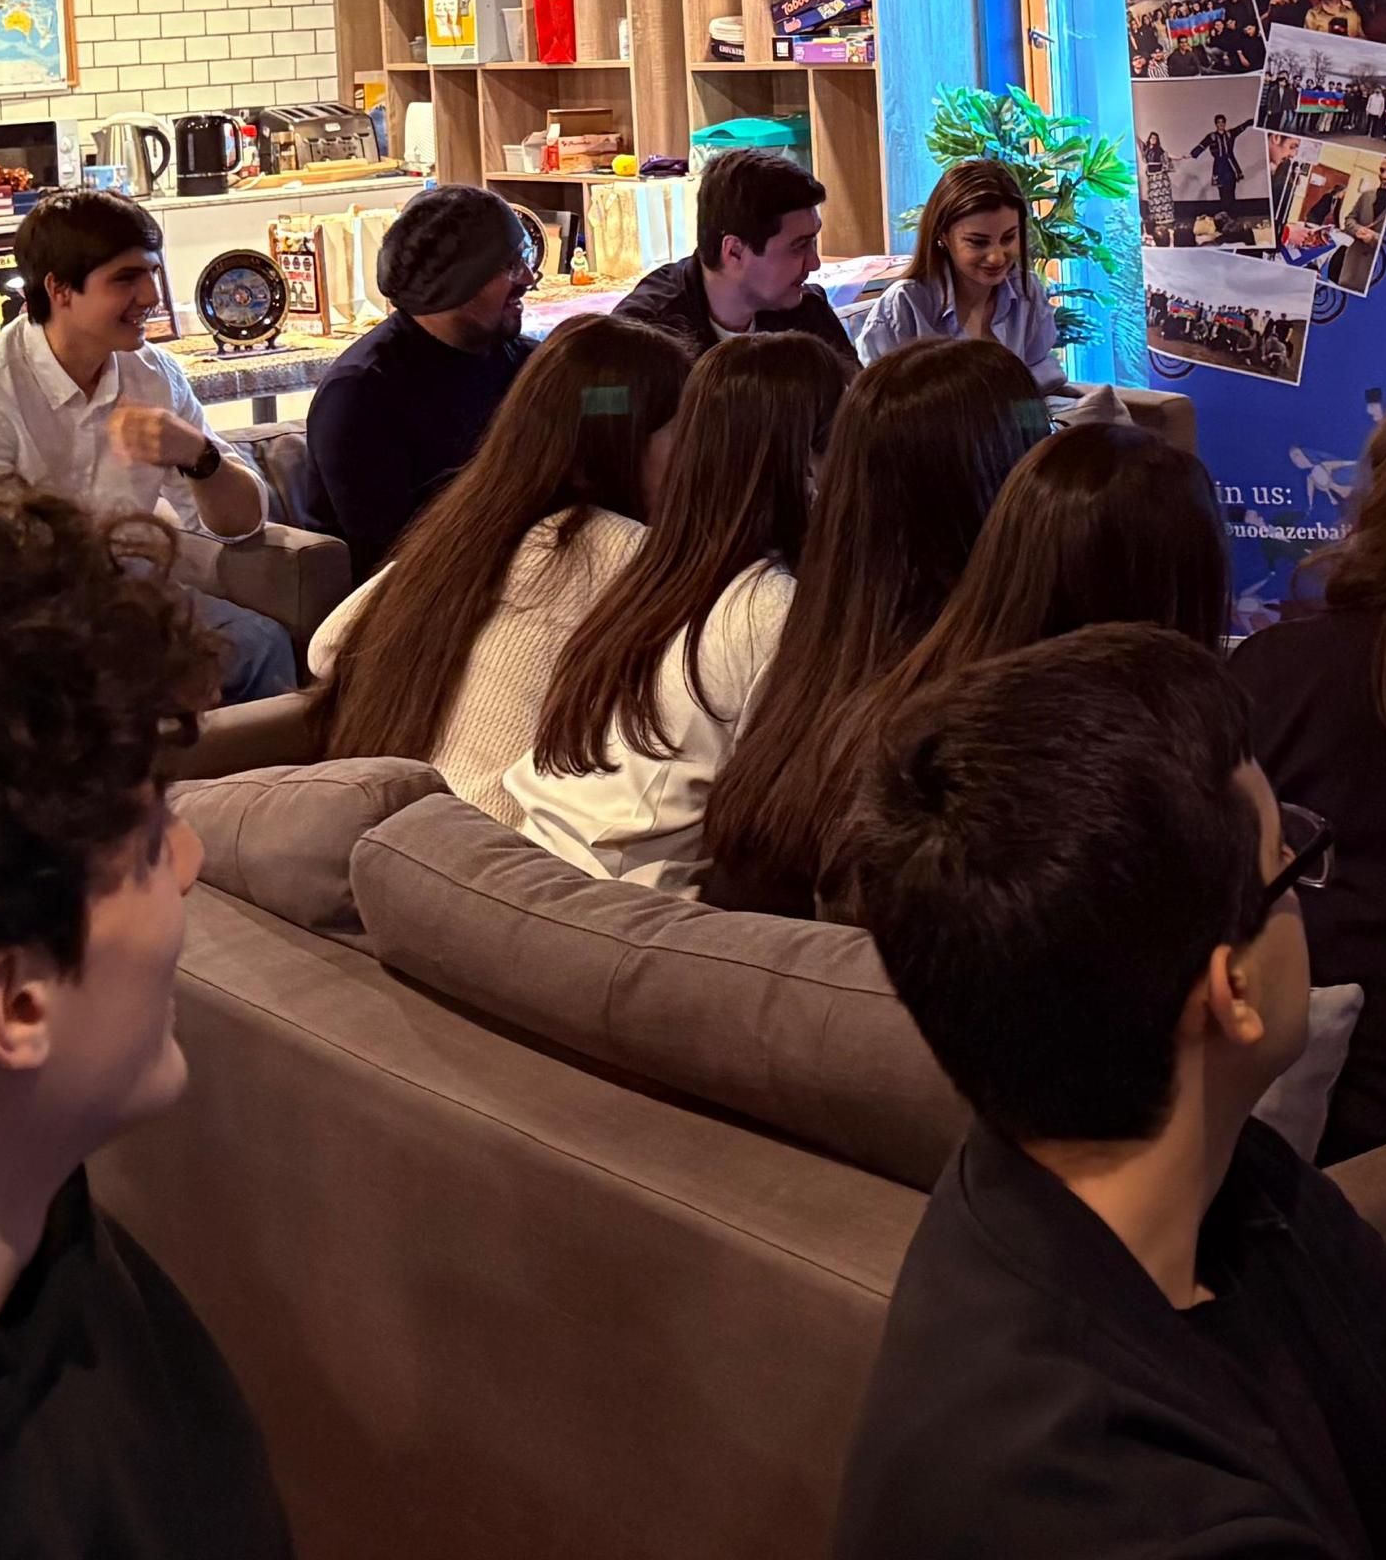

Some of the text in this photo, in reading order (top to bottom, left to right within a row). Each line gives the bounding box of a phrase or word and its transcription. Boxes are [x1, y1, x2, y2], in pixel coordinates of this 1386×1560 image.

[1215, 481, 1293, 505] in us:
[1225, 522, 1354, 540] uoe.azerbai
